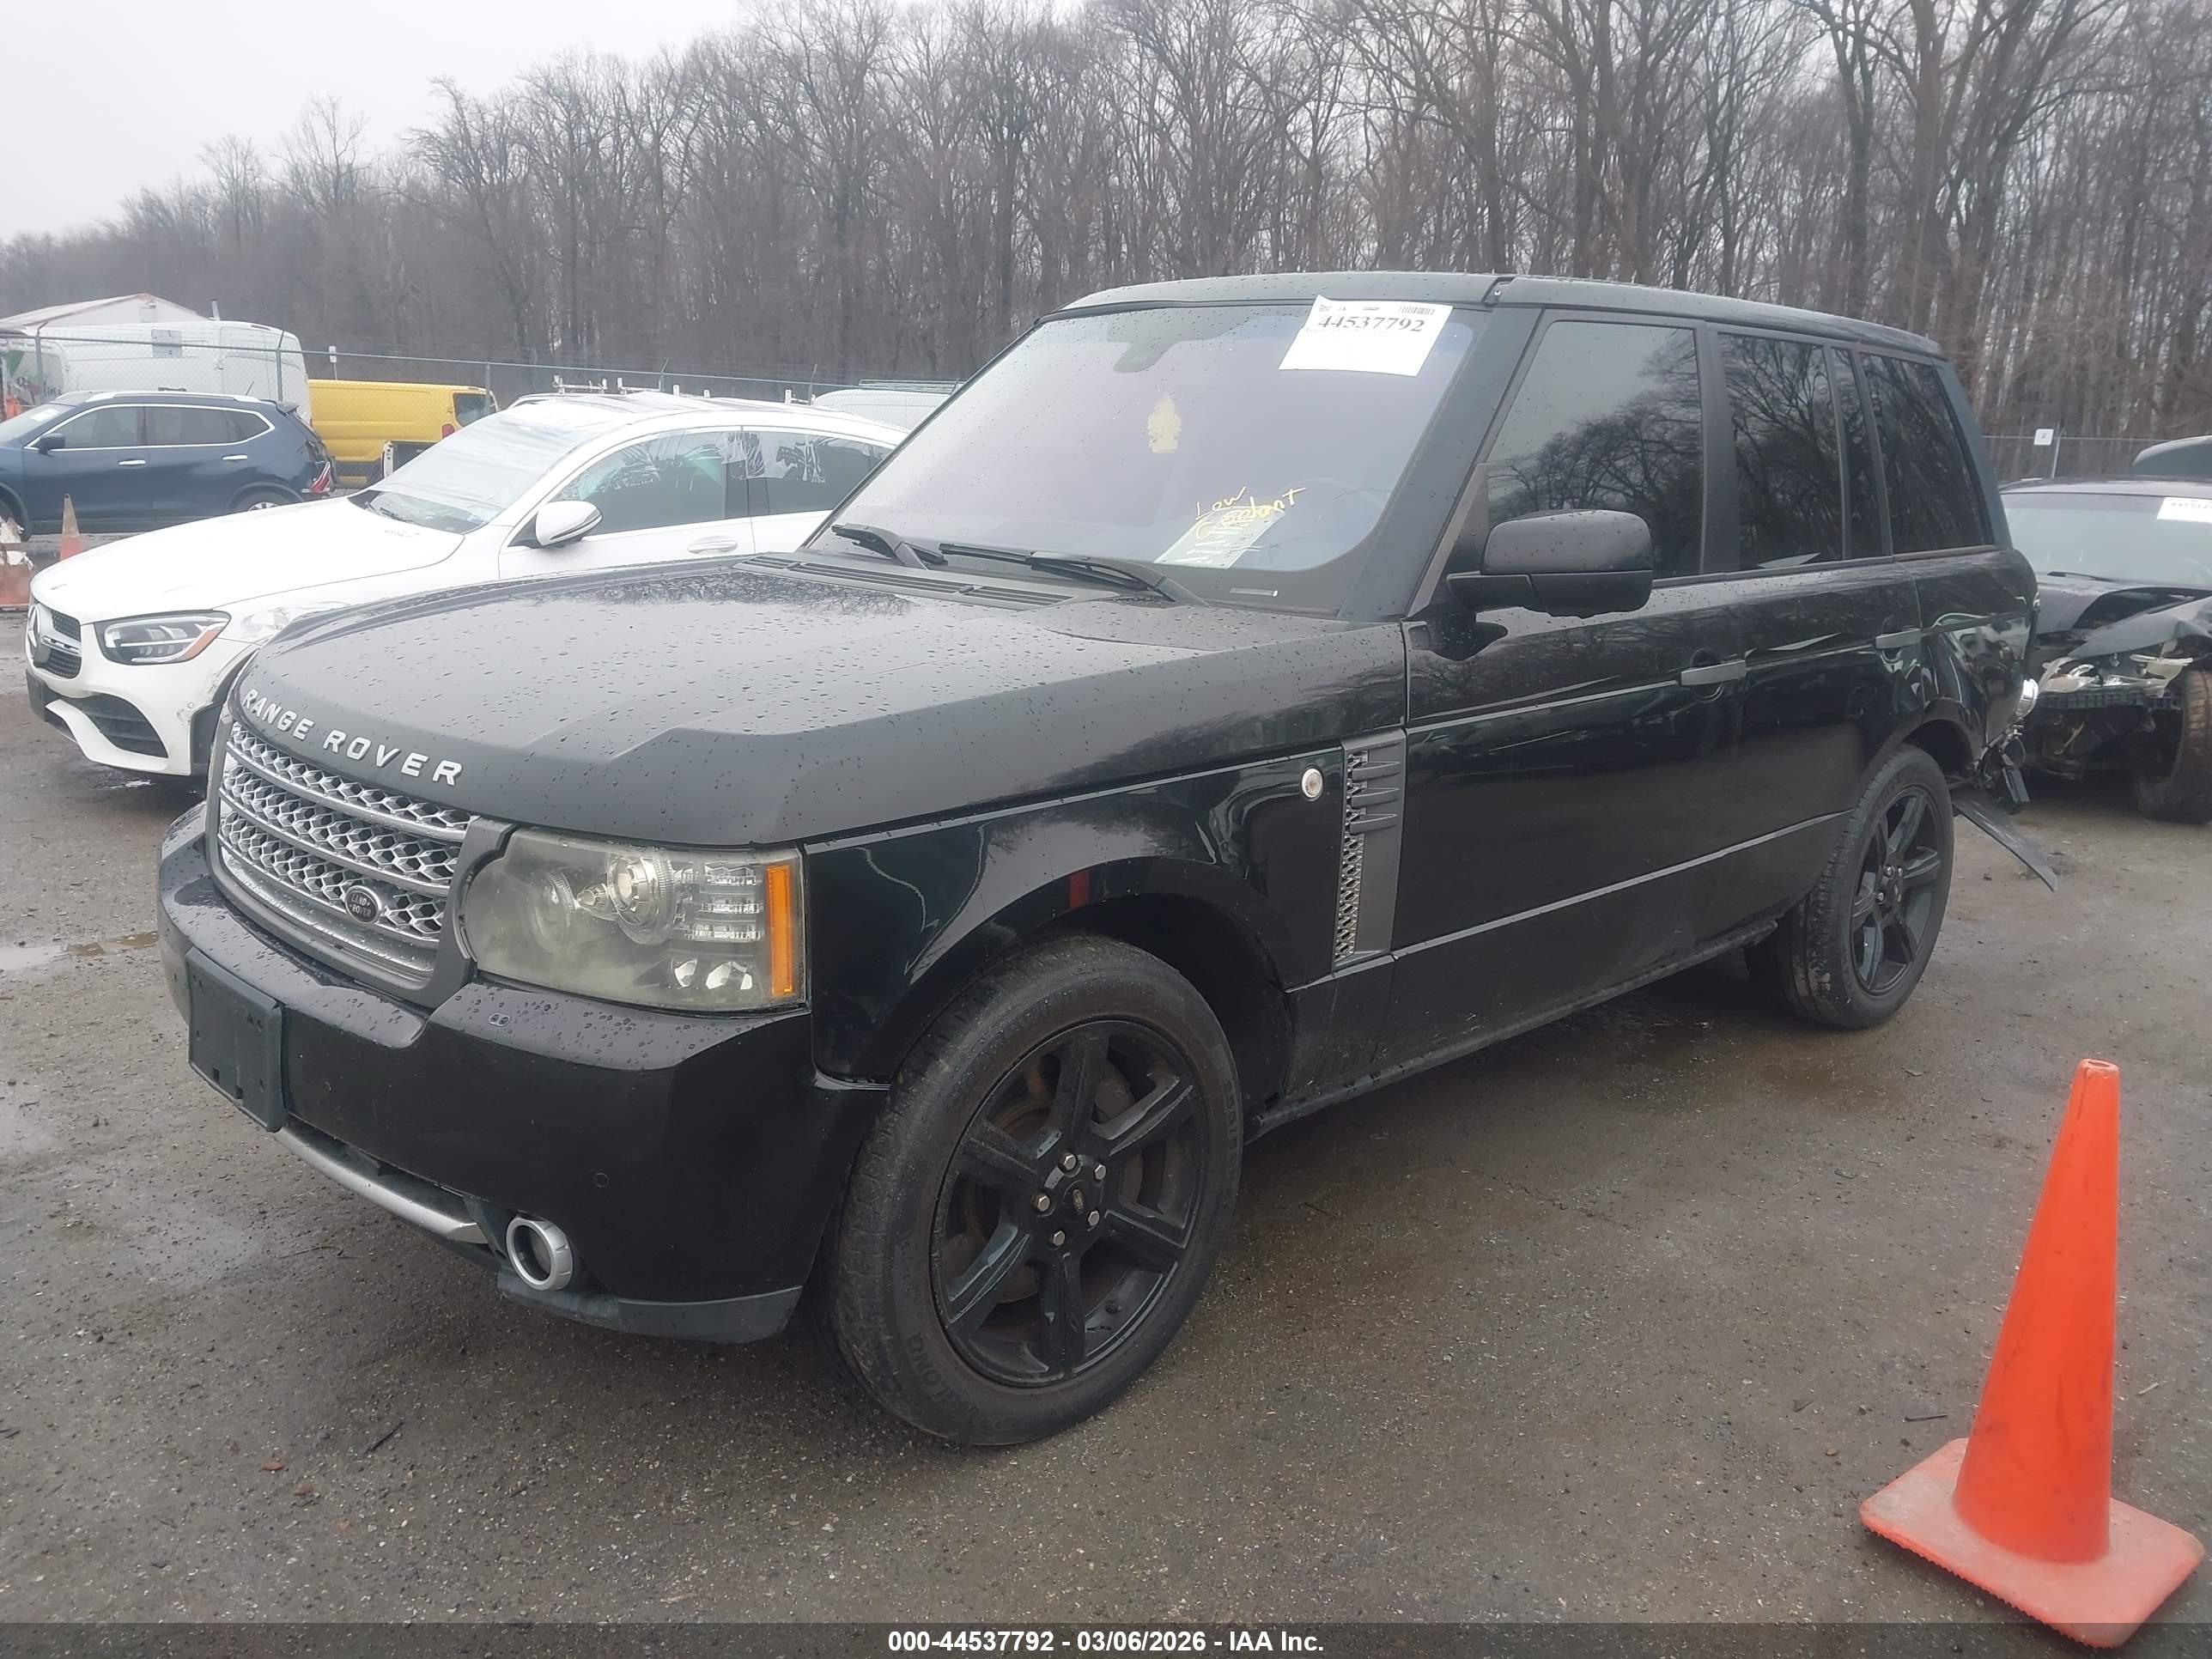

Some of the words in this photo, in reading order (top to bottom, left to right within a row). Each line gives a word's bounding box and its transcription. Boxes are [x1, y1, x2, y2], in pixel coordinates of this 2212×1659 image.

[1318, 315, 1425, 332] 44537792
[243, 689, 315, 740] RANGE
[323, 730, 463, 786] ROVER
